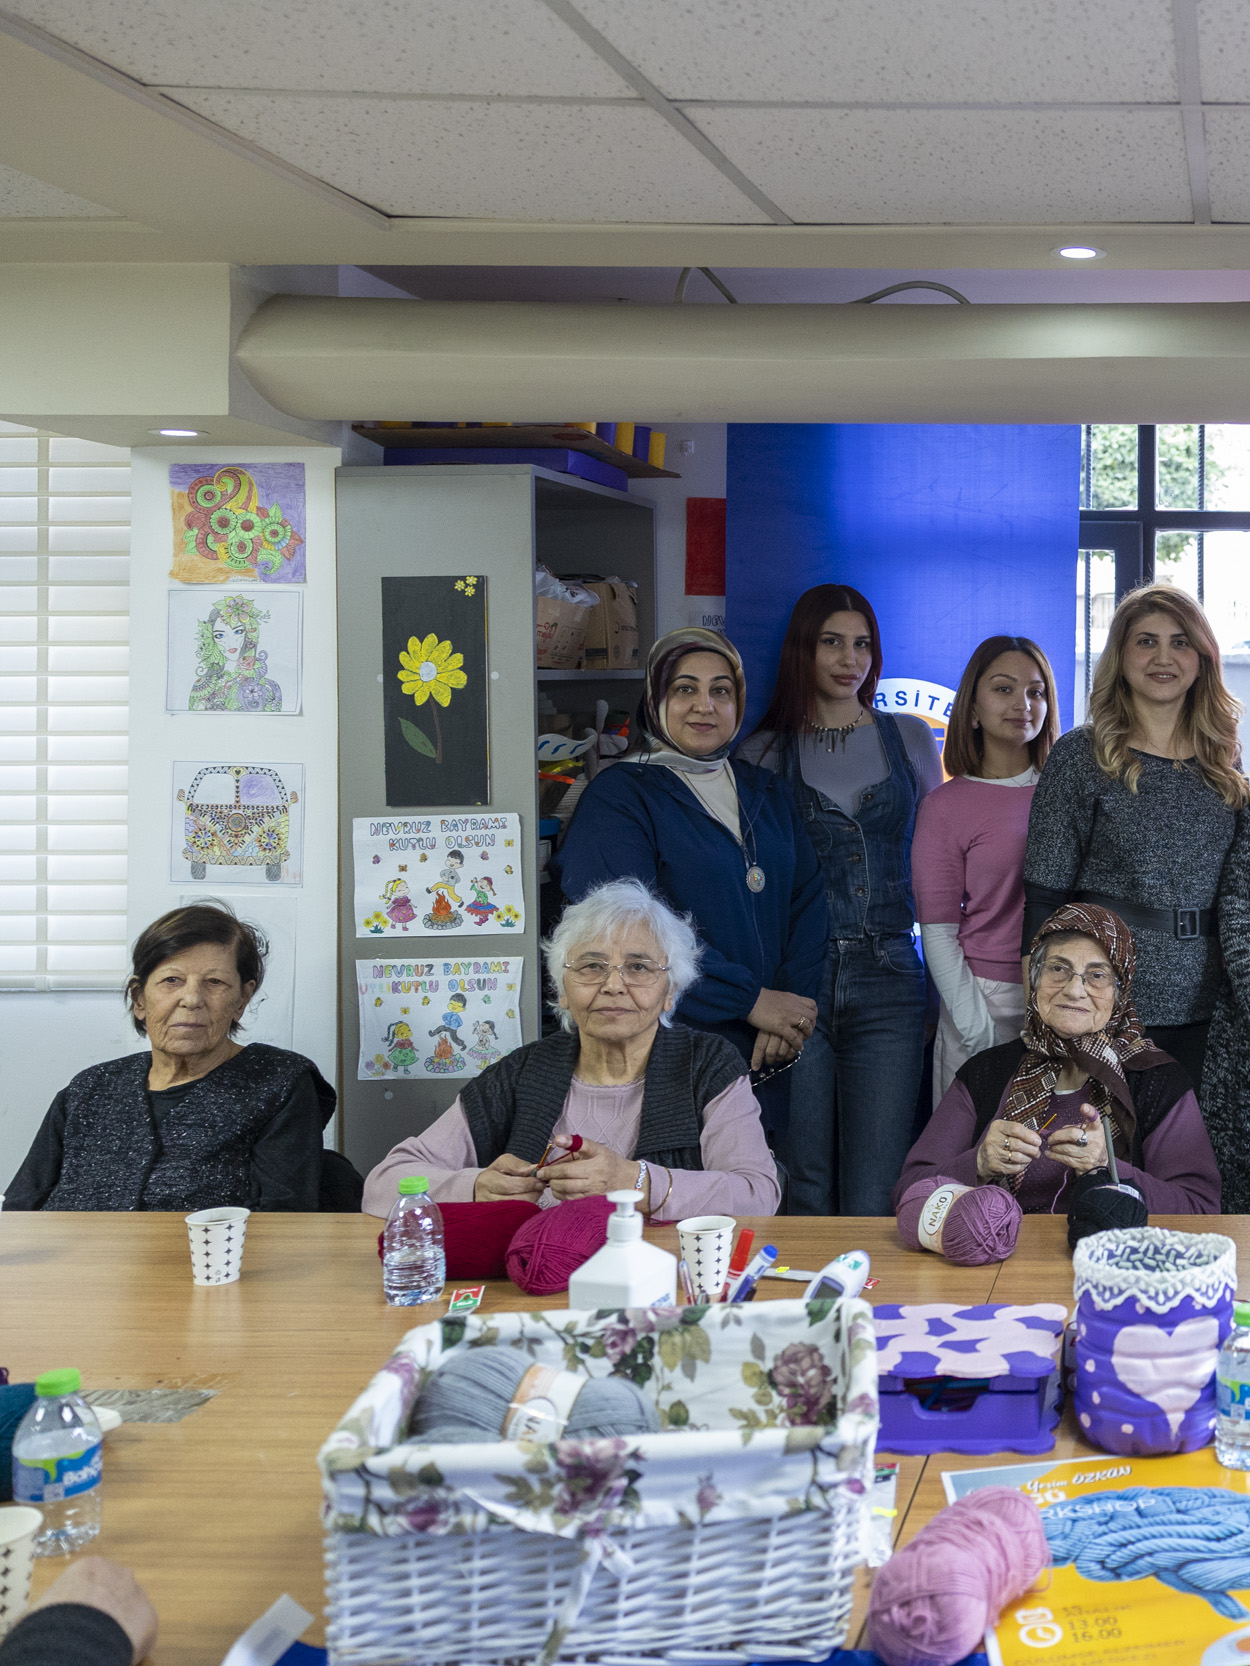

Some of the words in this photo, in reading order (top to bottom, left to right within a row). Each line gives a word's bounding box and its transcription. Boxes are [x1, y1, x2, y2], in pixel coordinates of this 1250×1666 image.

[702, 614, 726, 627] NEV
[874, 689, 954, 718] RSİTE
[370, 820, 432, 836] NEVRUZ
[440, 817, 508, 833] BAYRAMI
[388, 836, 436, 851] KUTLU
[445, 833, 496, 849] OLSUN
[372, 963, 434, 979] NEVRUZ
[443, 961, 510, 976] BAYRAMI
[448, 977, 498, 993] OLSUN
[928, 1196, 948, 1227] NAKO
[1040, 1498, 1156, 1520] RKSHOP
[1072, 1628, 1122, 1644] 16.00
